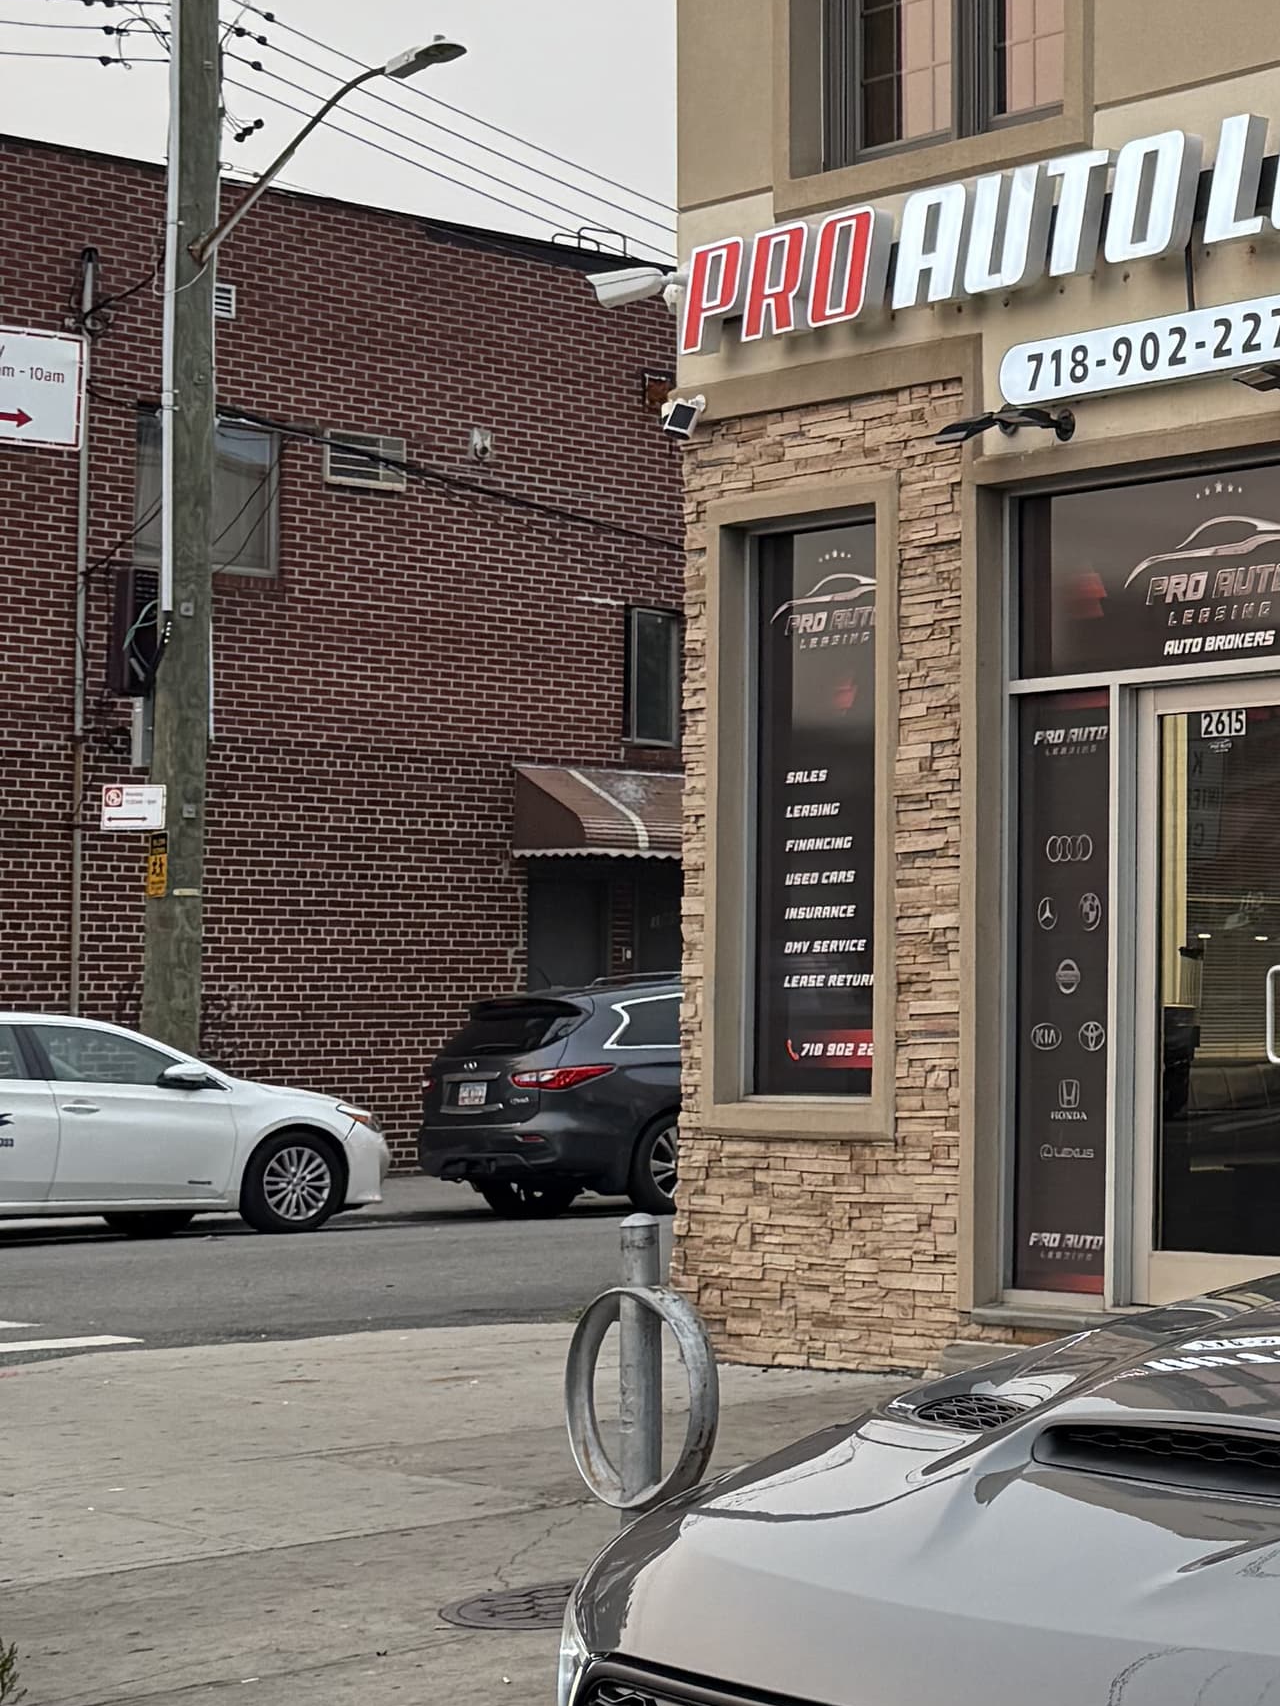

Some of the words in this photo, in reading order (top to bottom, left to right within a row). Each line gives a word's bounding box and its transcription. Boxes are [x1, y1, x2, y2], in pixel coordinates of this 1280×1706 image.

[680, 203, 890, 356] PRO
[891, 129, 1200, 311] AUTO
[29, 366, 65, 384] 10am
[1145, 572, 1209, 606] PRO
[1167, 600, 1273, 627] LEASING
[784, 612, 828, 636] PRO
[799, 631, 871, 650] LEASING
[1163, 635, 1203, 656] AUTO
[1203, 629, 1276, 653] BROKERS
[1203, 709, 1245, 736] 2615
[1033, 728, 1066, 746] PRO
[1067, 724, 1110, 744] AUTO
[785, 769, 828, 785] SALES
[785, 802, 841, 819] LEASING
[785, 836, 853, 853] FINANCING
[785, 871, 819, 887] USED
[820, 870, 857, 885] CARS
[784, 904, 857, 921] INSURANCE
[784, 940, 811, 955] DMV
[812, 938, 867, 954] SERVICE
[783, 974, 826, 989] LEASE
[1036, 1028, 1058, 1045] KIA
[825, 1042, 855, 1057] 902
[1050, 1110, 1089, 1122] HONDA
[1054, 1147, 1095, 1159] LEXUS
[1028, 1231, 1061, 1248] PRO
[1061, 1233, 1104, 1252] AUTO
